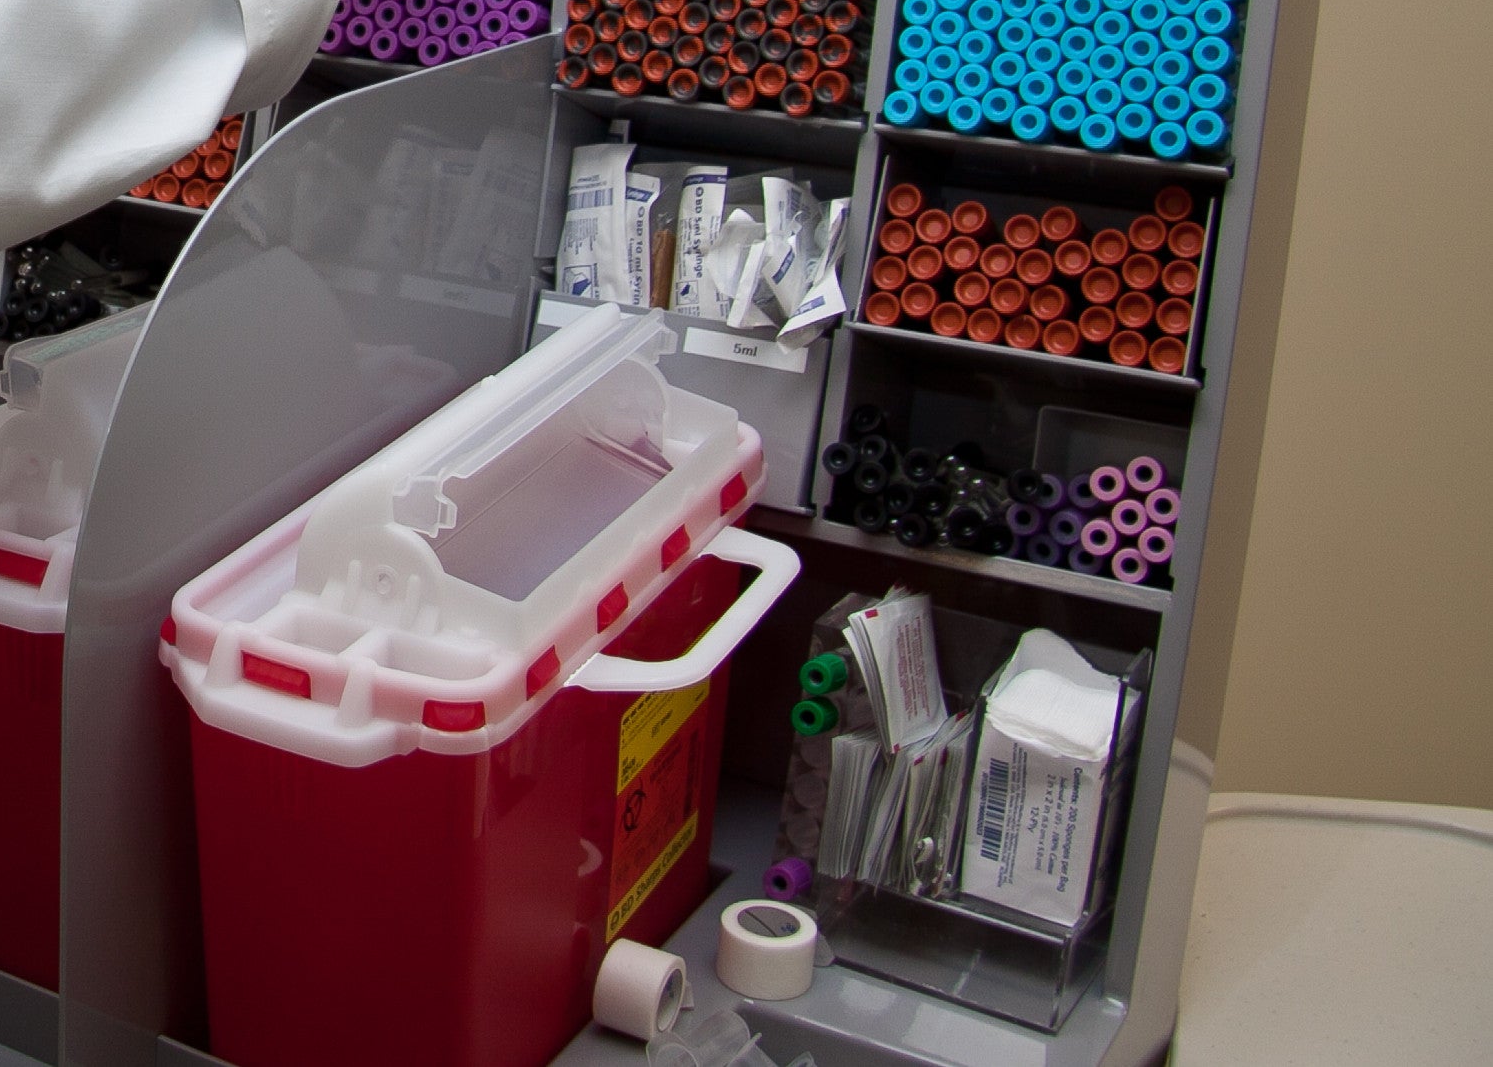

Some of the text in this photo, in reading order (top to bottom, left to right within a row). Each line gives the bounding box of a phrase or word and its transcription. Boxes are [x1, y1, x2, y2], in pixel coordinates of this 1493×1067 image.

[693, 239, 703, 278] Syringe
[733, 343, 758, 357] 5ml
[1027, 806, 1039, 834] 12-Ply
[1068, 806, 1078, 822] 200
